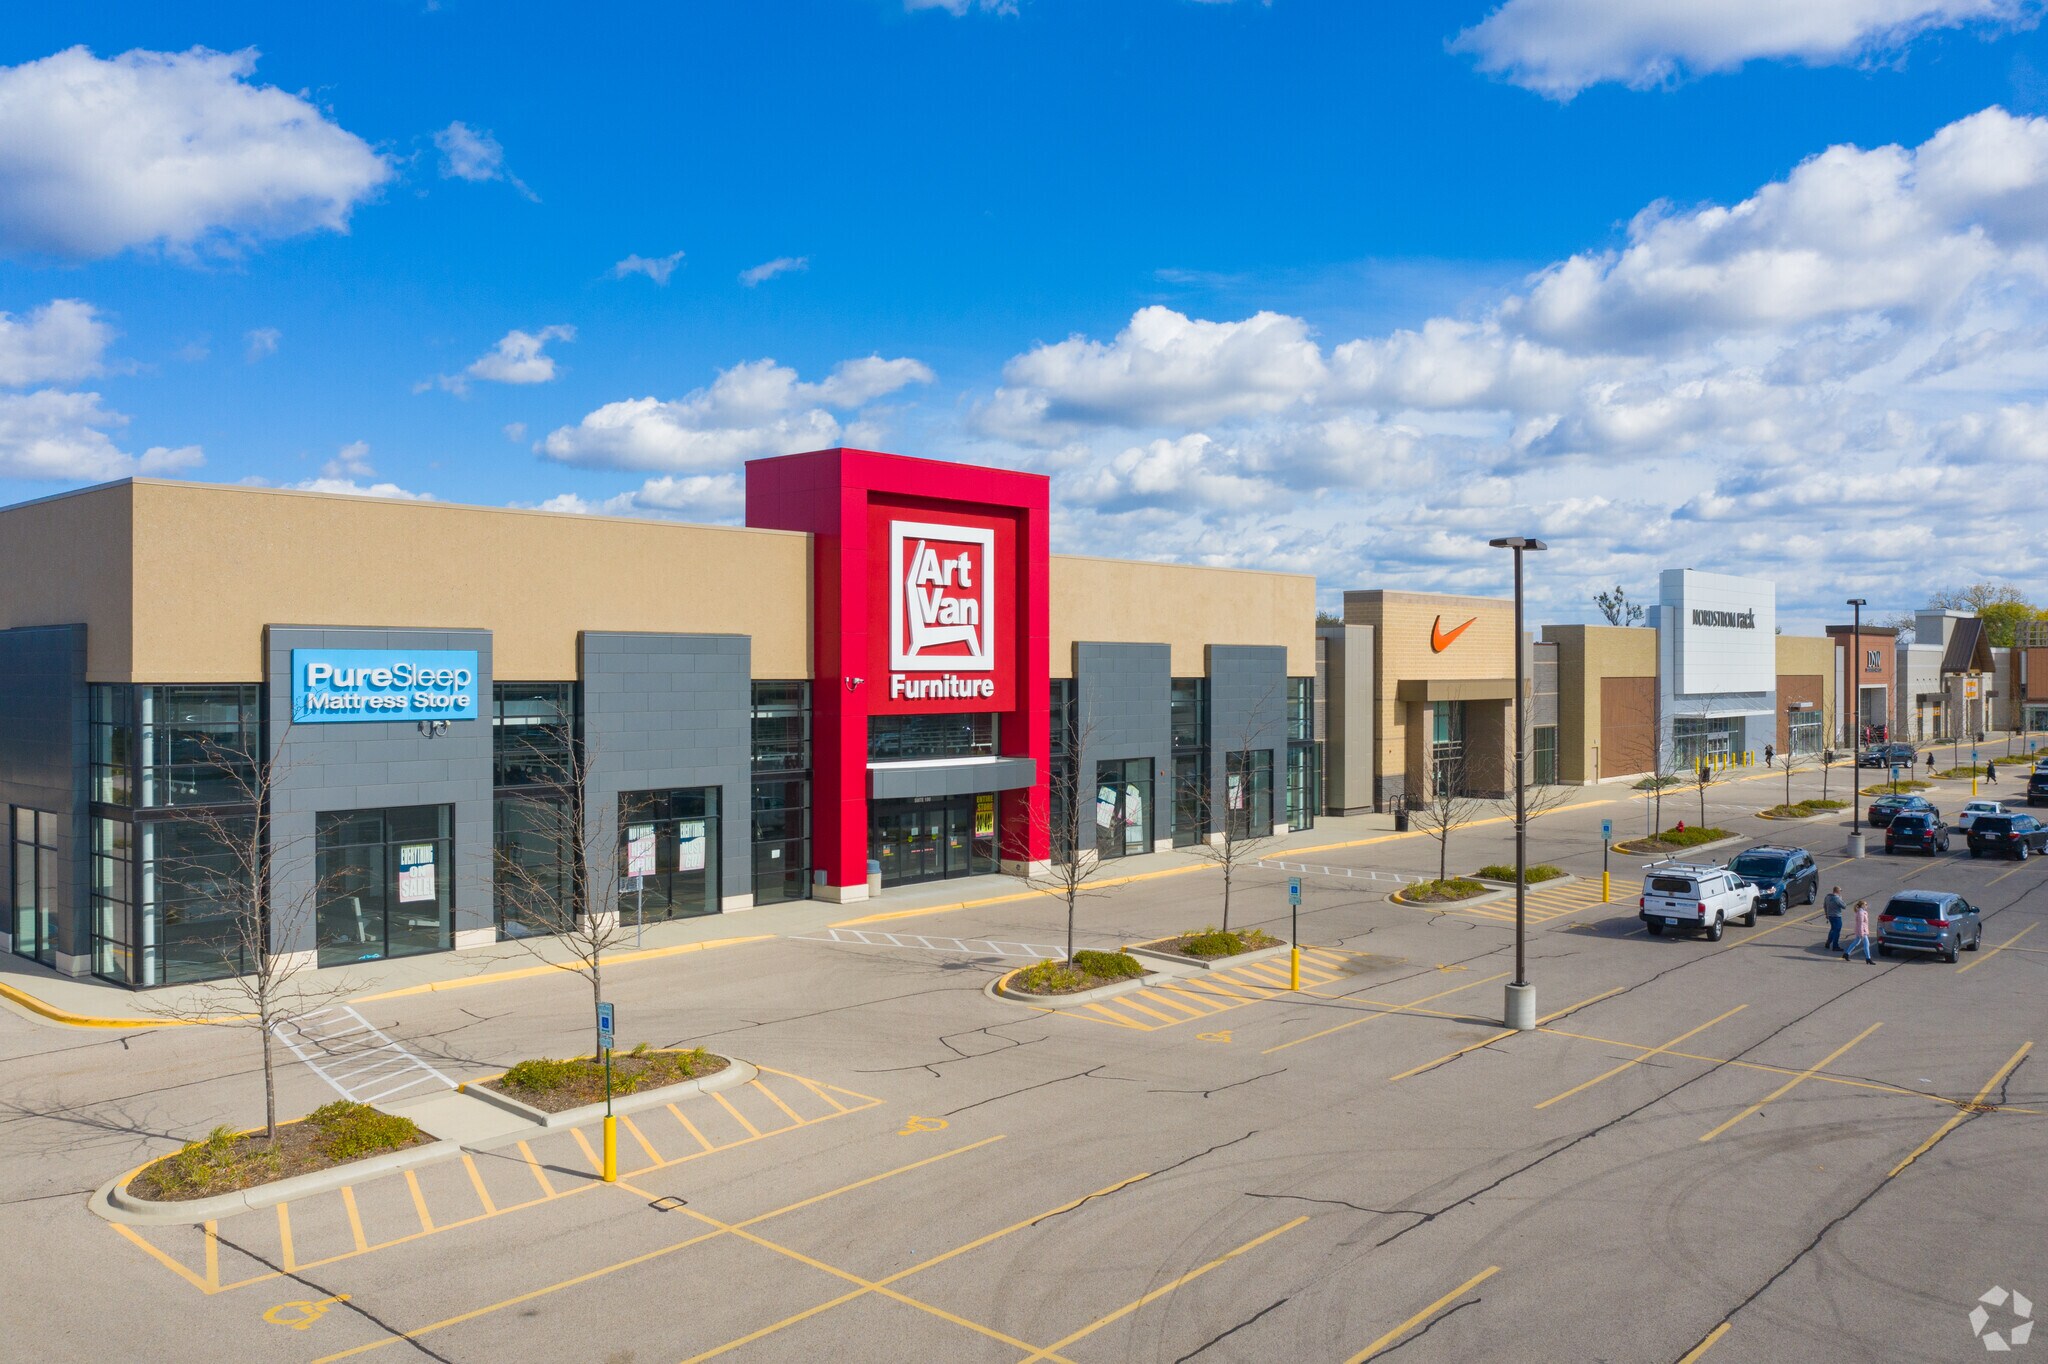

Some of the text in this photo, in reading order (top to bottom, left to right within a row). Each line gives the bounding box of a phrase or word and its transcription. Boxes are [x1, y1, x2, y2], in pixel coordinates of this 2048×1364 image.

[916, 549, 972, 588] Art
[916, 587, 979, 625] Van
[1692, 608, 1755, 629] NORDSTROM rack
[1866, 650, 1880, 667] DSW
[306, 662, 472, 692] PureSleep
[891, 674, 994, 699] Furniture
[306, 692, 471, 710] Mattress Store
